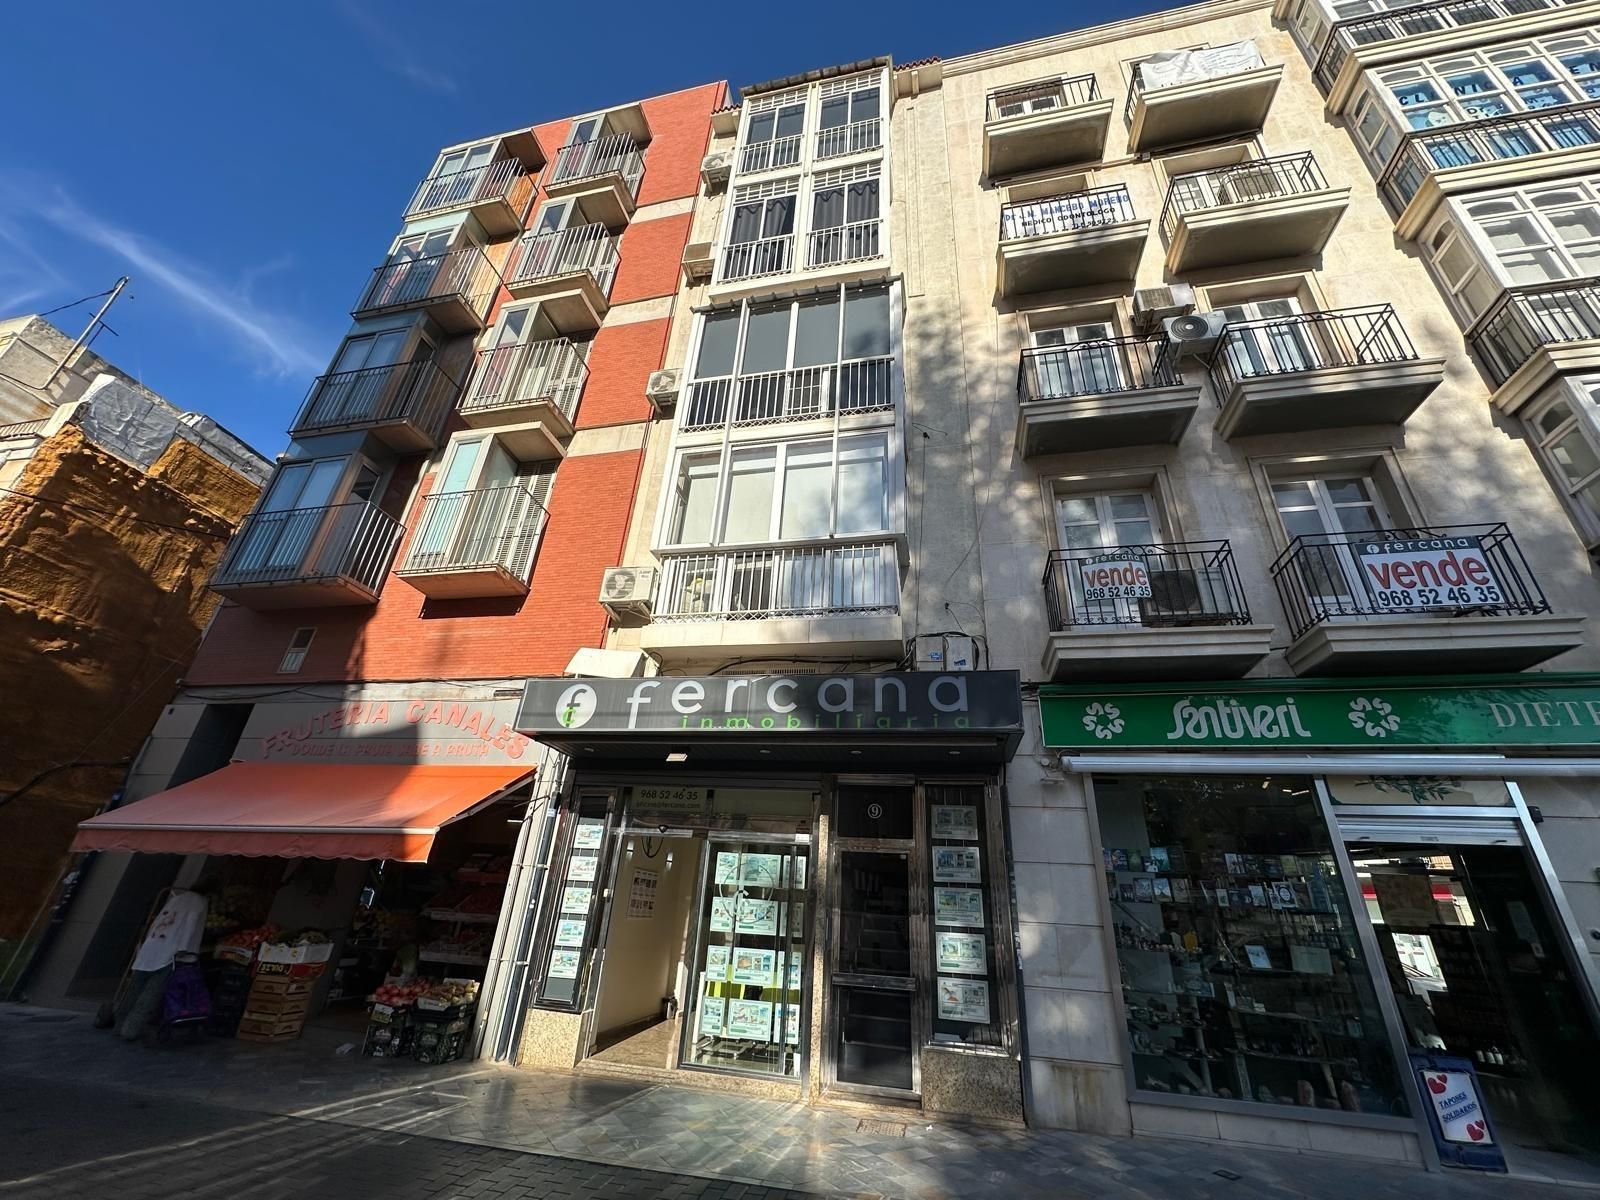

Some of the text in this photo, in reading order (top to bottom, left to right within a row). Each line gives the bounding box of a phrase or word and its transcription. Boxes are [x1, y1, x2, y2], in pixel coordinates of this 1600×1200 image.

[1021, 207, 1116, 228] MEDICO ODONTOLOGO
[1041, 203, 1085, 216] MANCEBO
[1383, 537, 1469, 554] fercana
[1095, 553, 1140, 564] fercana
[1083, 561, 1147, 589] vende
[1366, 550, 1490, 590] vende
[1086, 585, 1152, 600] 968 52 46 35
[1378, 585, 1501, 607] 968 52 46 35
[625, 675, 969, 730] fercana
[1166, 697, 1312, 740] Santiveri
[261, 699, 530, 760] FRUTERIA CANALES
[640, 790, 698, 800] 968 52 46 35
[1439, 1092, 1468, 1110] TAPONES
[1442, 1103, 1478, 1121] SOLIDARIOS
